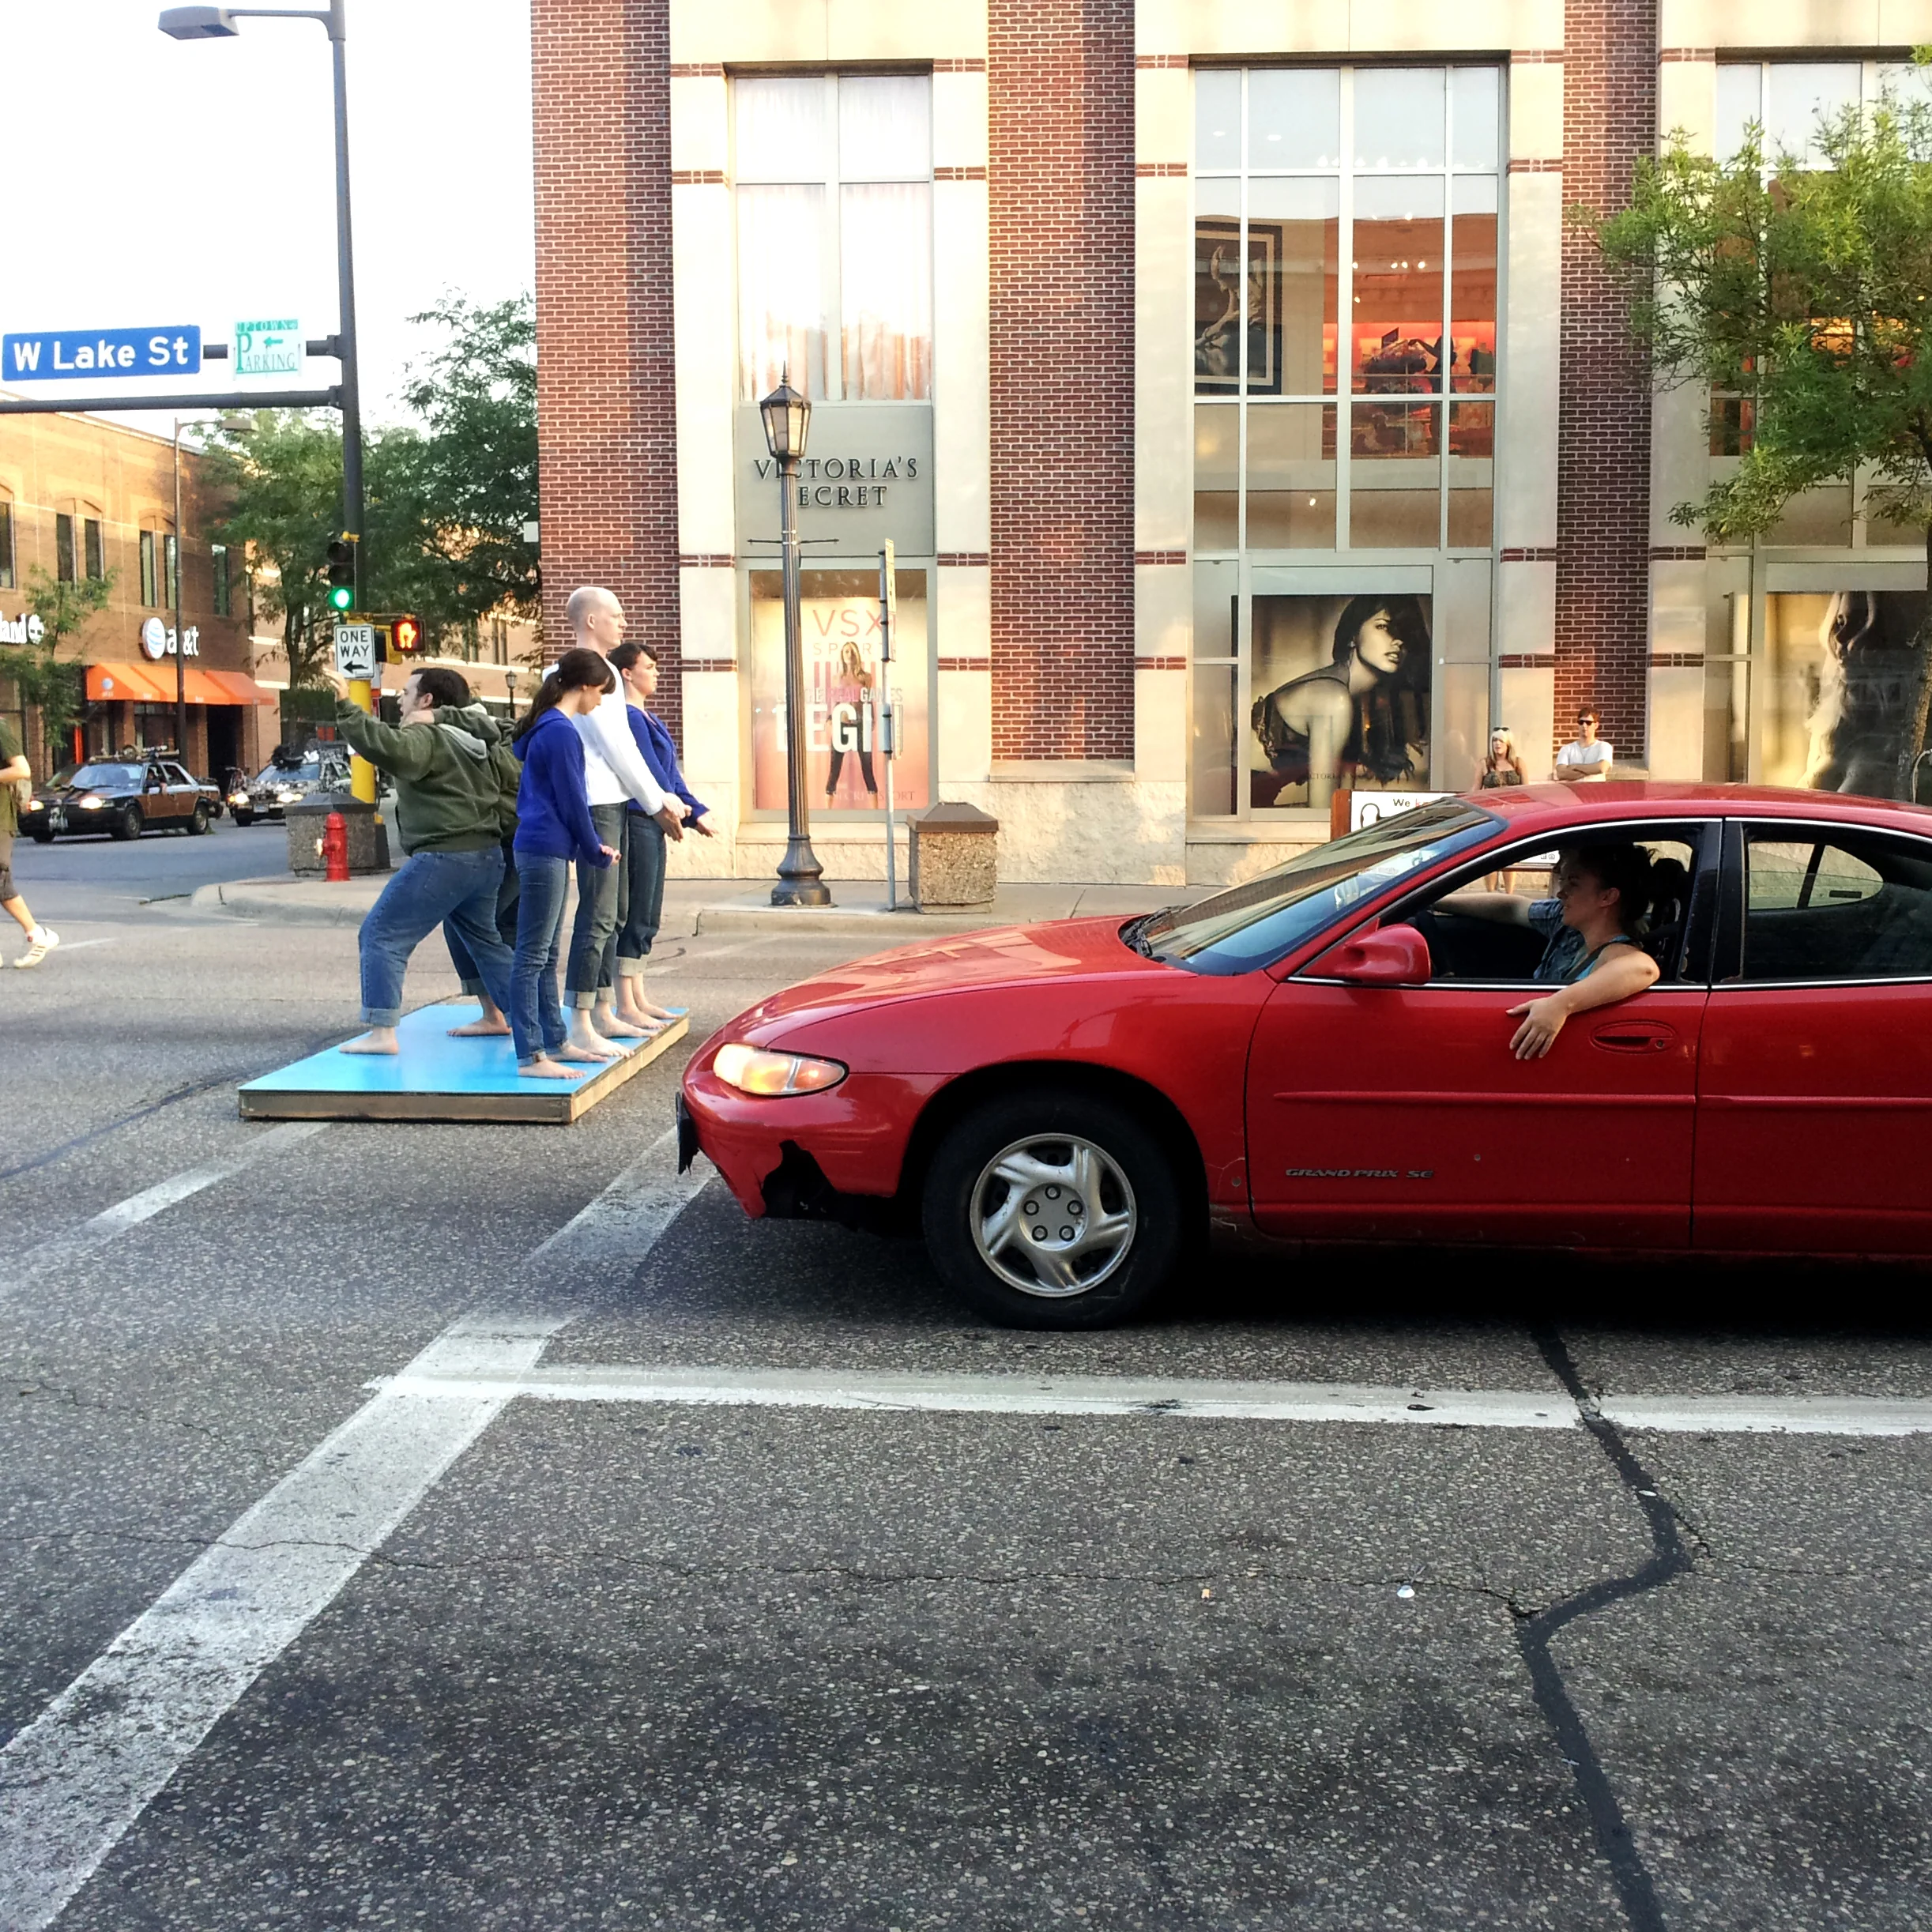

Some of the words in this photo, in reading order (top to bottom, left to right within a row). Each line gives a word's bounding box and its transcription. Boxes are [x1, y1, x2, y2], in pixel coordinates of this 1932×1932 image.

[13, 341, 41, 371] W
[53, 339, 136, 370] Lake
[148, 336, 189, 366] St
[798, 486, 887, 507] ECRET
[167, 625, 199, 656] a&t
[340, 630, 368, 643] ONE
[340, 645, 369, 657] WAY
[1393, 798, 1410, 807] We
